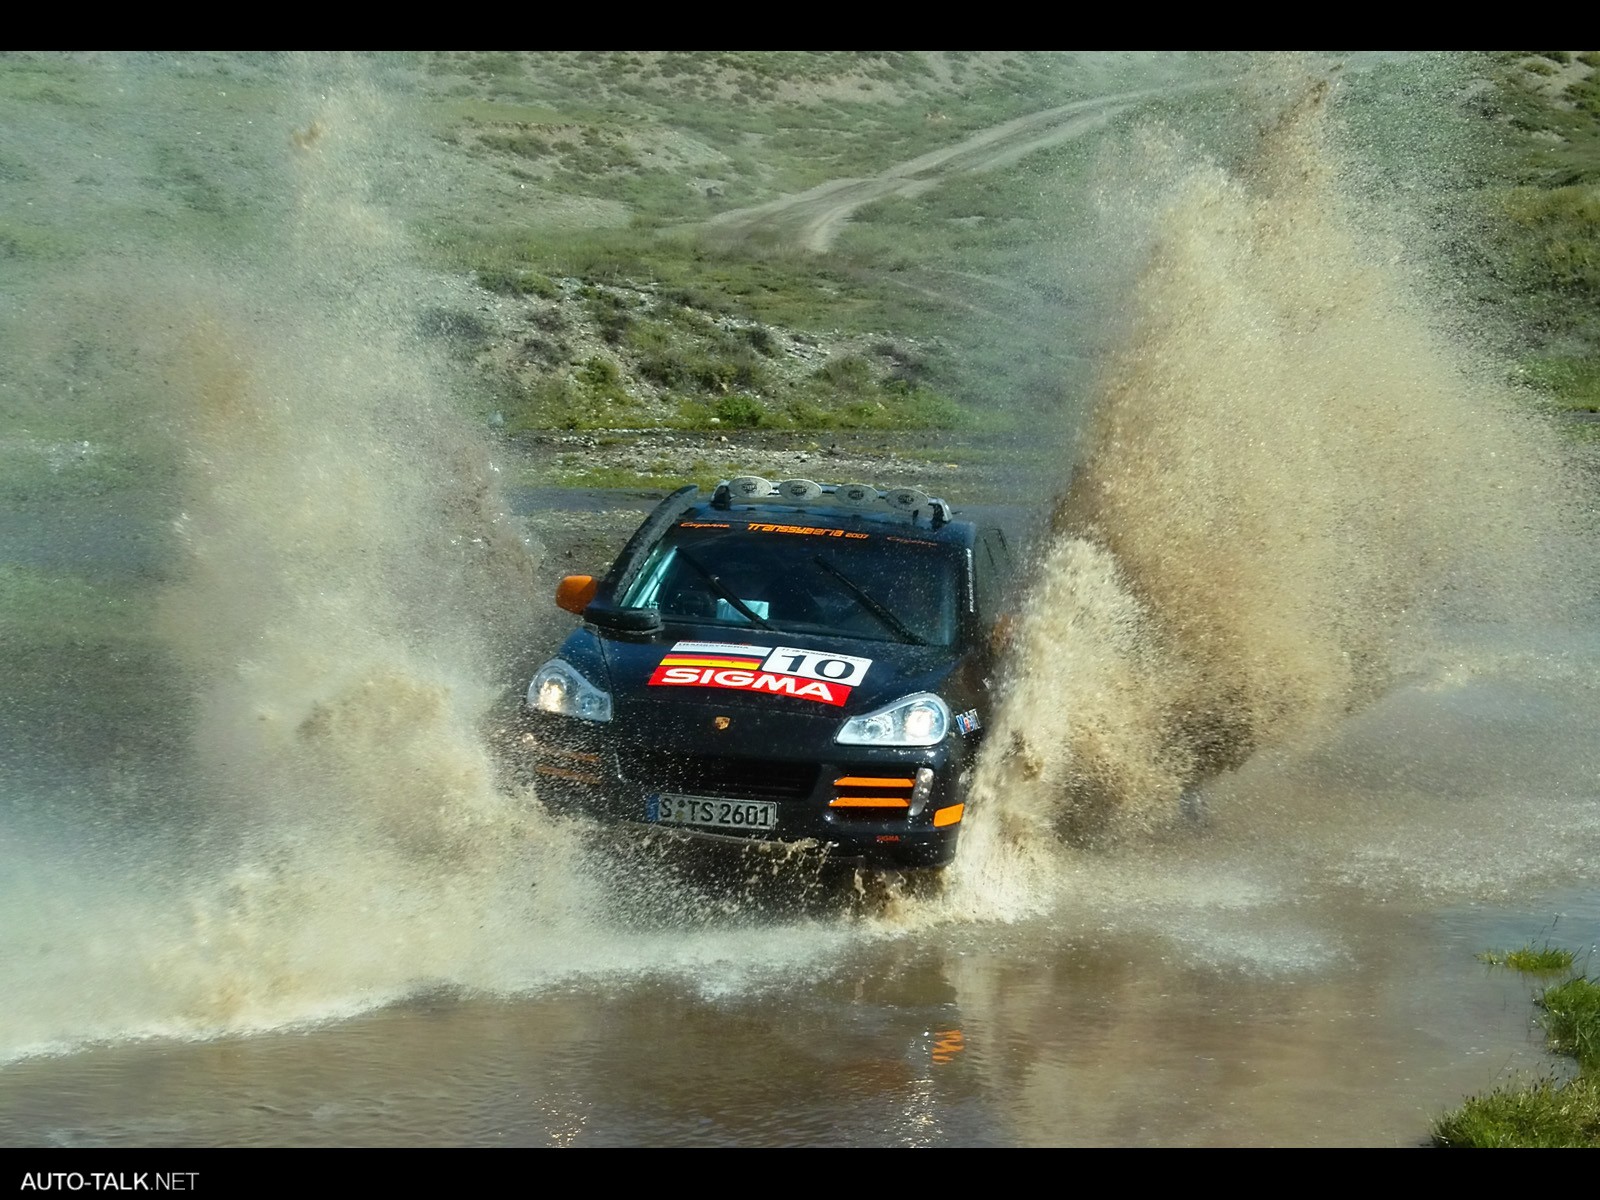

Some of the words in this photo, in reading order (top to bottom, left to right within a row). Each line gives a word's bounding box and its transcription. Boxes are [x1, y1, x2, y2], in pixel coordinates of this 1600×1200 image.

[781, 654, 855, 680] 10
[662, 668, 833, 701] SIGMA
[661, 798, 673, 818] S
[718, 803, 769, 826] 2601
